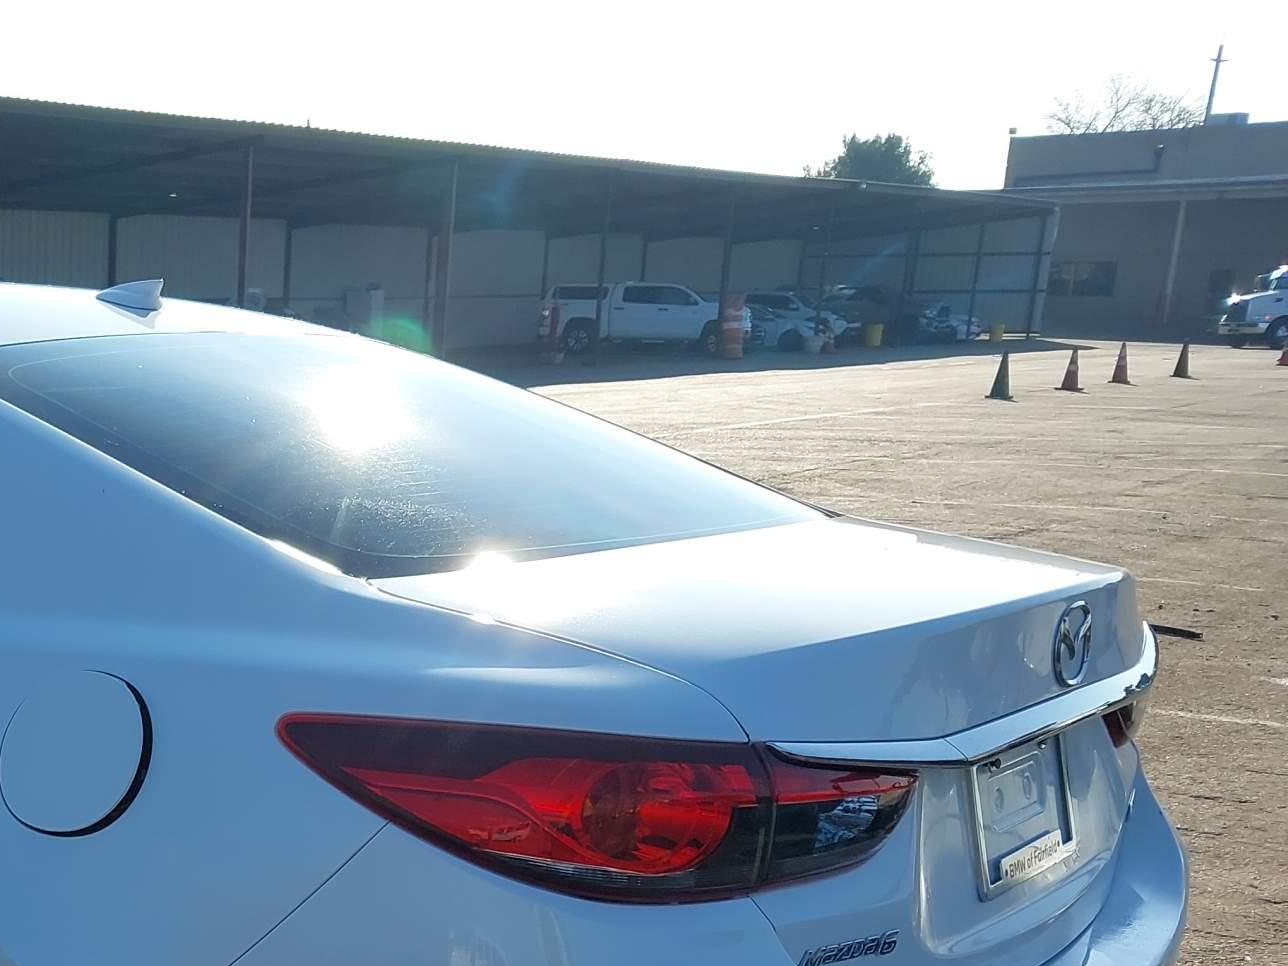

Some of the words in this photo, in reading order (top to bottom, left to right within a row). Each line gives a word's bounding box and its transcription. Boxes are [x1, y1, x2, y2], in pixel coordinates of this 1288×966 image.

[1008, 855, 1026, 878] BMW
[1027, 852, 1034, 868] of
[1034, 839, 1058, 864] Fairfield
